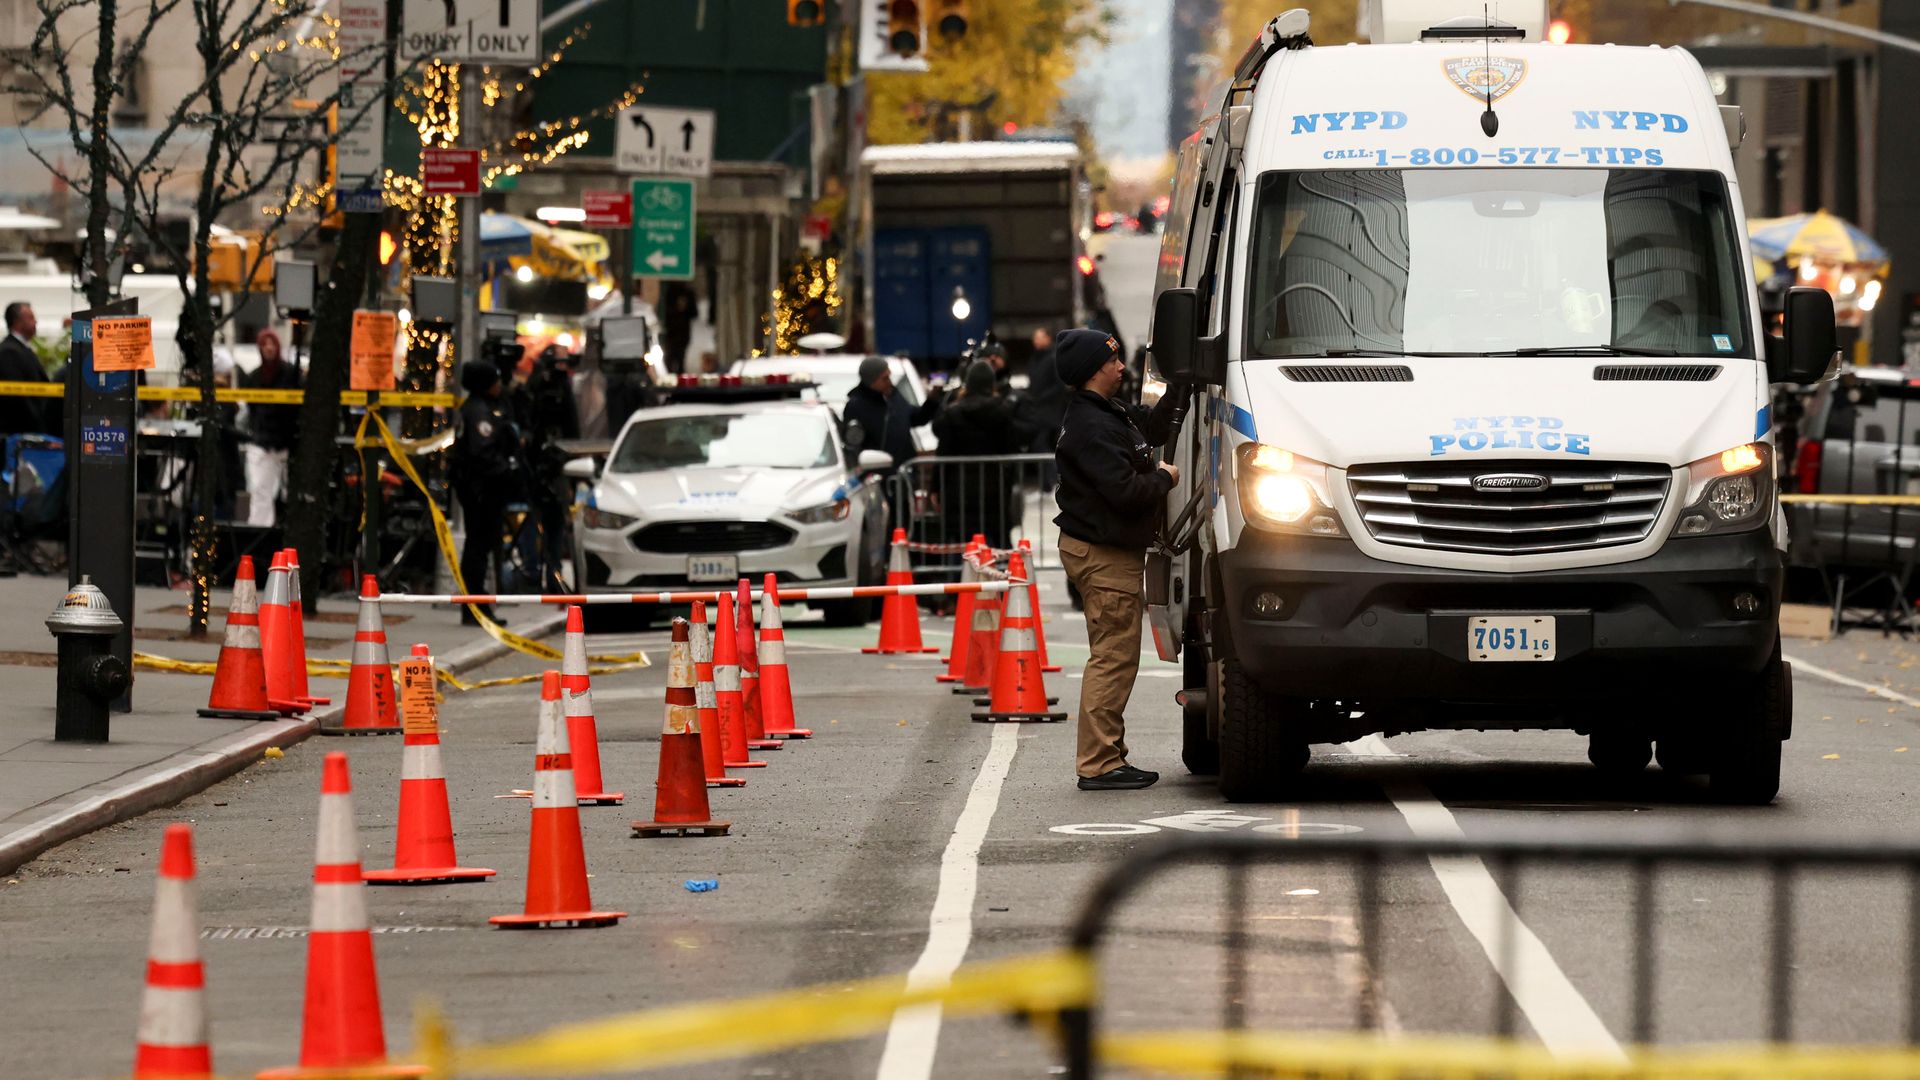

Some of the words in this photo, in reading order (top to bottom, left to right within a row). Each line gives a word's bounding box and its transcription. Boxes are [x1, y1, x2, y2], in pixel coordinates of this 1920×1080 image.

[410, 32, 462, 50] ONLY
[477, 34, 530, 52] ONLY
[1290, 110, 1408, 134] NYPD
[1571, 110, 1689, 133] NYPD
[1323, 148, 1374, 160] CALL:
[1375, 146, 1664, 166] 1-800-577-TIPS
[647, 231, 675, 242] Park
[113, 321, 149, 329] PARKING
[1453, 415, 1565, 431] NYPD
[84, 431, 125, 442] 103578
[1429, 430, 1591, 456] POLICE
[1482, 477, 1540, 487] FREIGHTLINER
[1474, 627, 1529, 650] 7051
[1533, 639, 1549, 650] 16
[405, 666, 419, 675] NO
